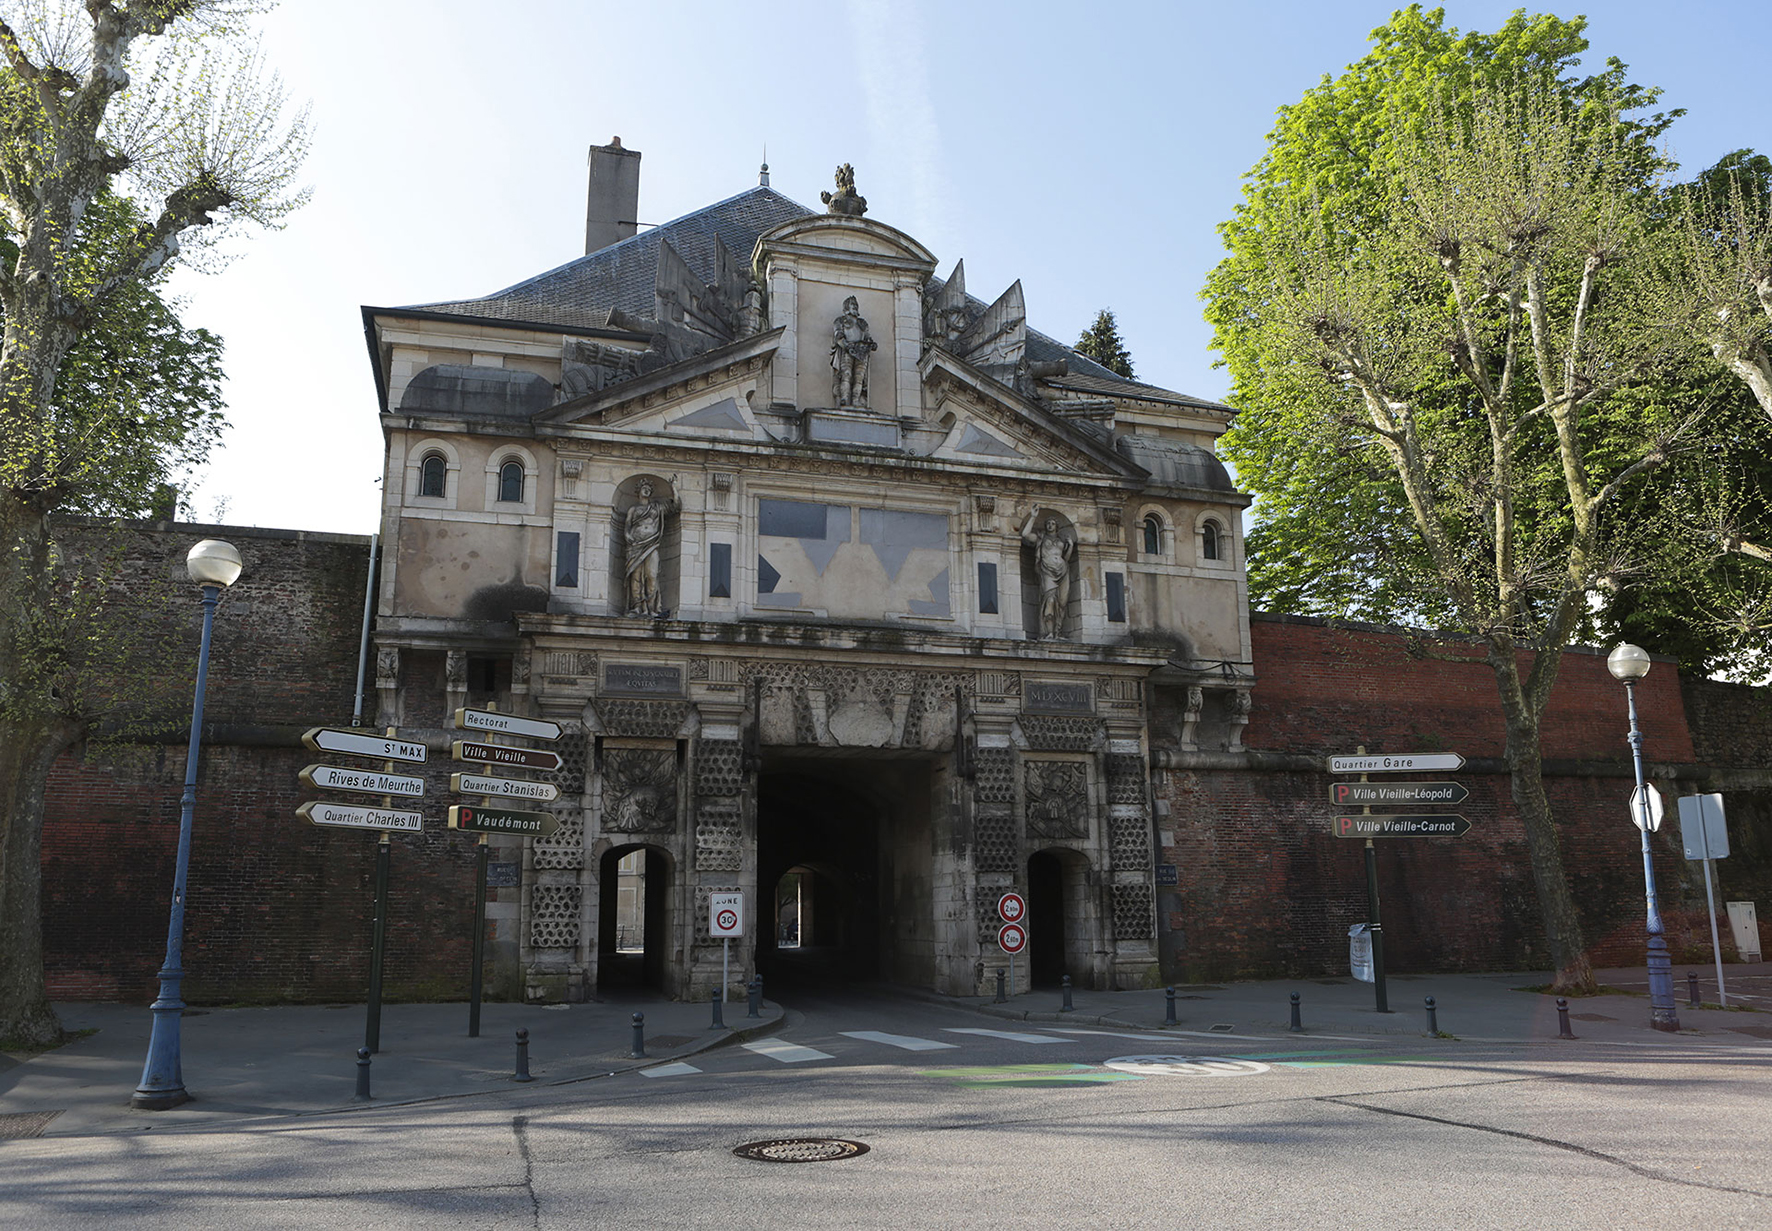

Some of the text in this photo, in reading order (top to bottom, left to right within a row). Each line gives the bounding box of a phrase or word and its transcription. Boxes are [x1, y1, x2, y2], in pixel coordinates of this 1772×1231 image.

[467, 714, 508, 729] Rectorat
[400, 745, 422, 758] MAX
[464, 746, 526, 763] Ville Vieille
[1334, 757, 1413, 769] Quartier Gare
[329, 771, 421, 793] Rives de Meurthe
[463, 779, 550, 798] Quartier Stanislas
[1337, 785, 1452, 803] P Ville Vieille-Léopold
[324, 810, 419, 828] Quartier Charles III
[461, 808, 541, 830] P Vaudémont
[1341, 818, 1455, 835] P Ville Vieille-Carnot
[721, 916, 732, 924] 30
